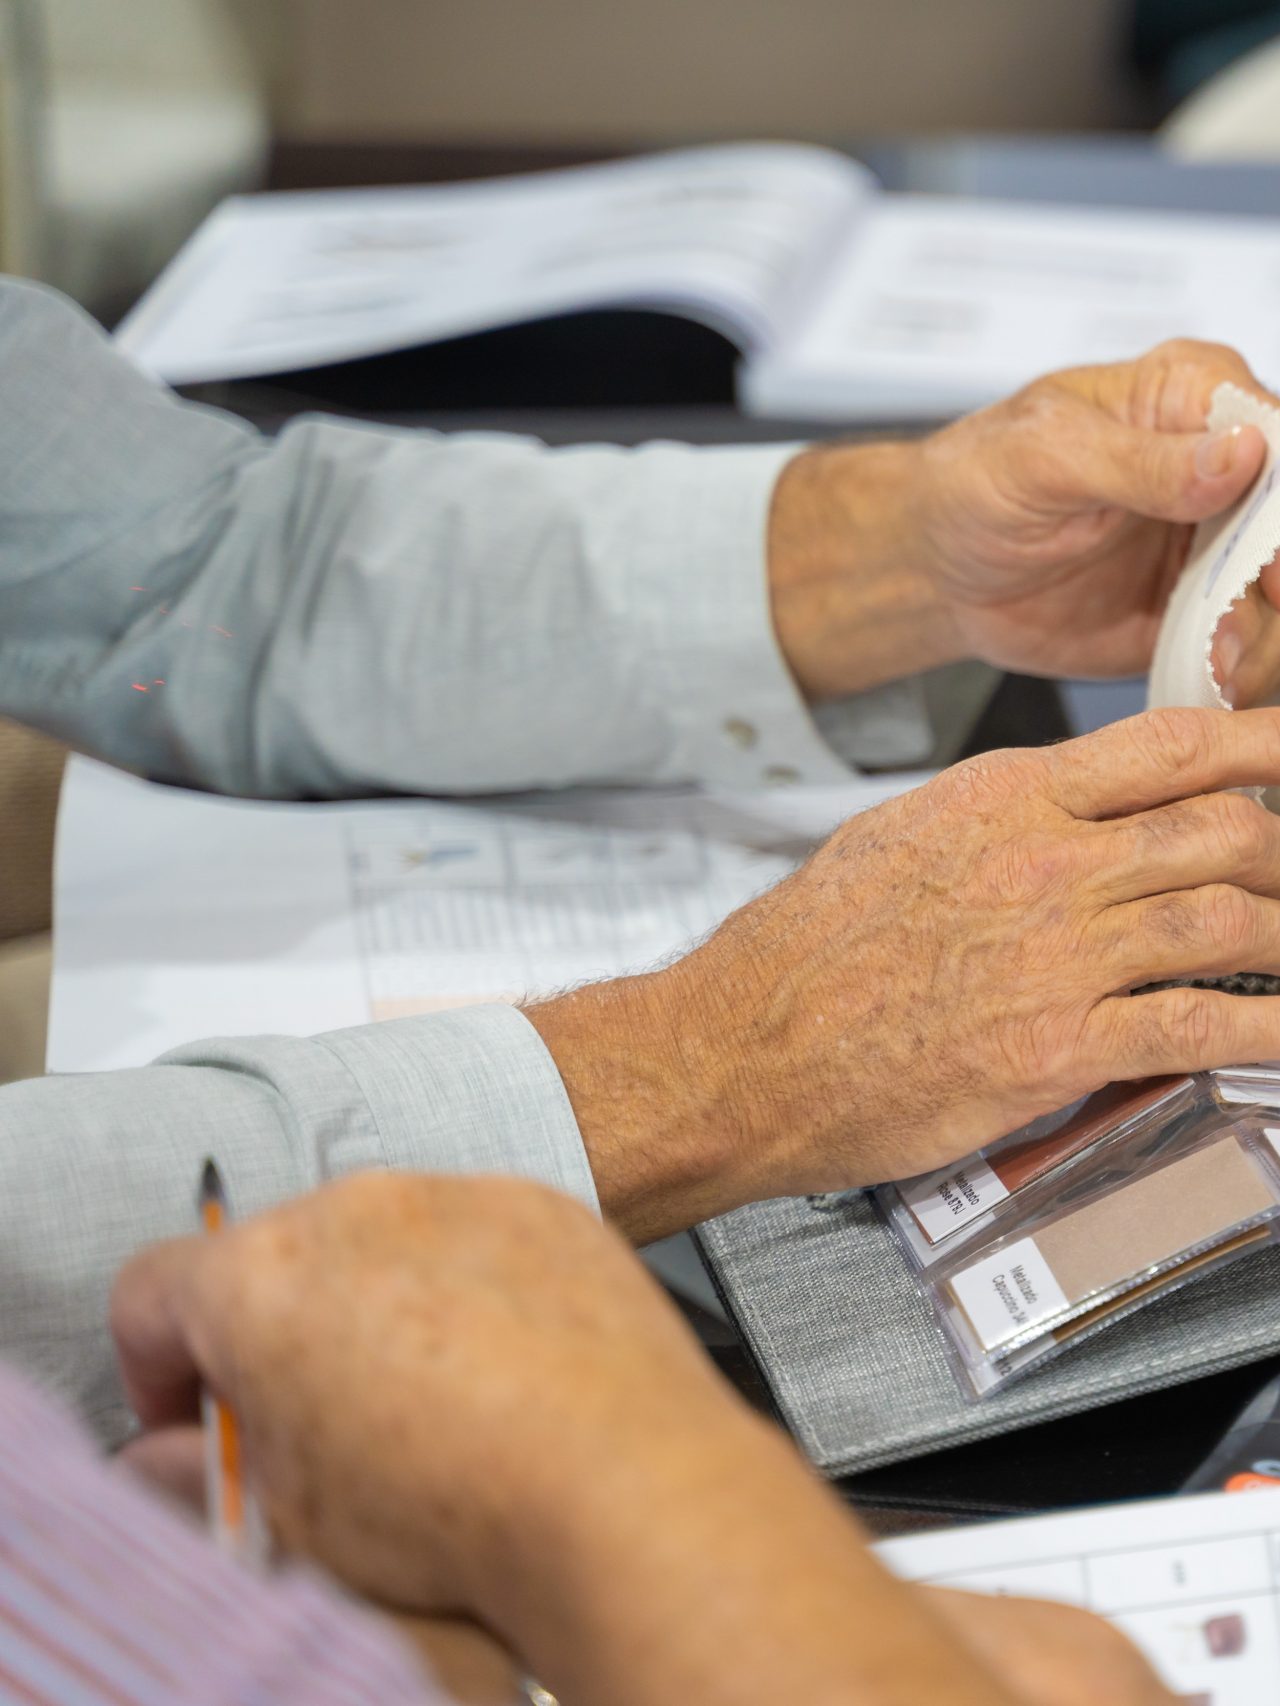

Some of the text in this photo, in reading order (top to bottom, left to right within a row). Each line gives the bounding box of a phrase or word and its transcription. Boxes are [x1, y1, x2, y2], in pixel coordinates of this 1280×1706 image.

[936, 1181, 953, 1201] Rose
[953, 1170, 980, 1206] Metalizado
[1009, 1264, 1038, 1304] Metalizado
